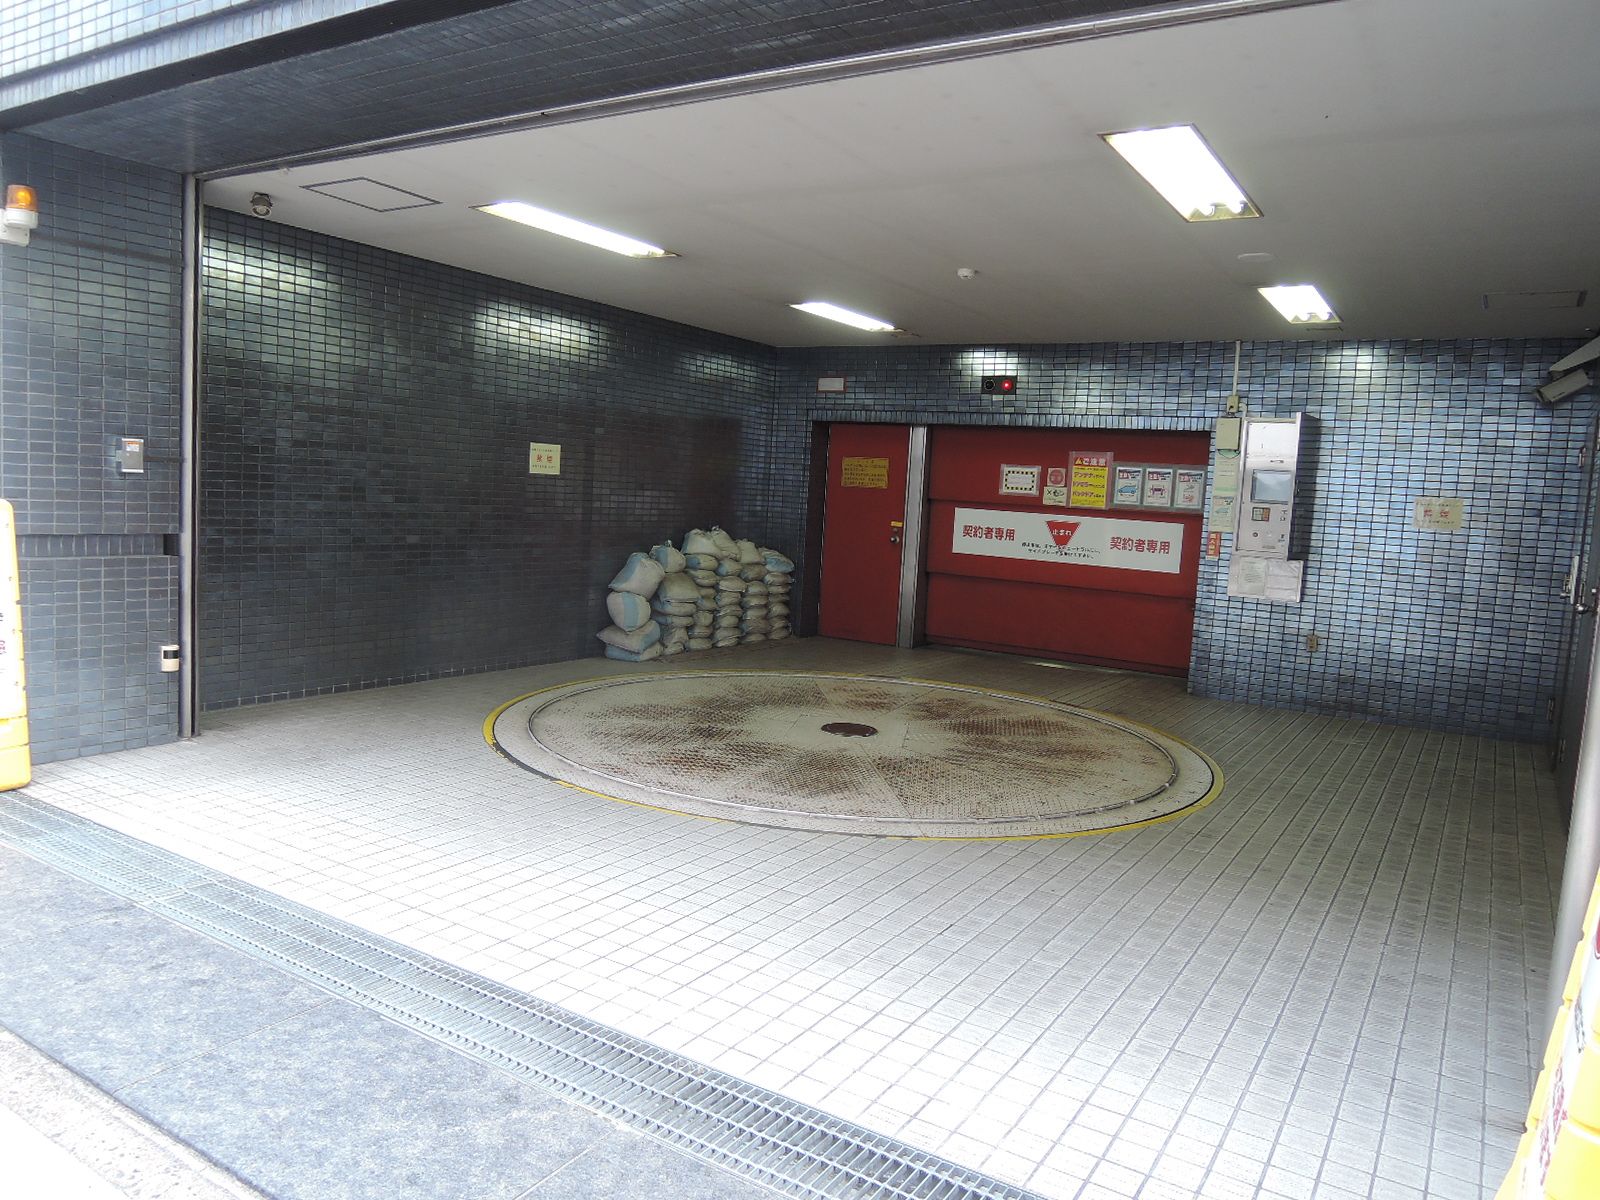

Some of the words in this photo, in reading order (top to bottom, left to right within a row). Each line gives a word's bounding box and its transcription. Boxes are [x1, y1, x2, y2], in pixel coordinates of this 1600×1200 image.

[962, 524, 1016, 541] 契約者専用
[1052, 528, 1072, 536] 止まれ
[1110, 536, 1171, 555] 契約者専用
